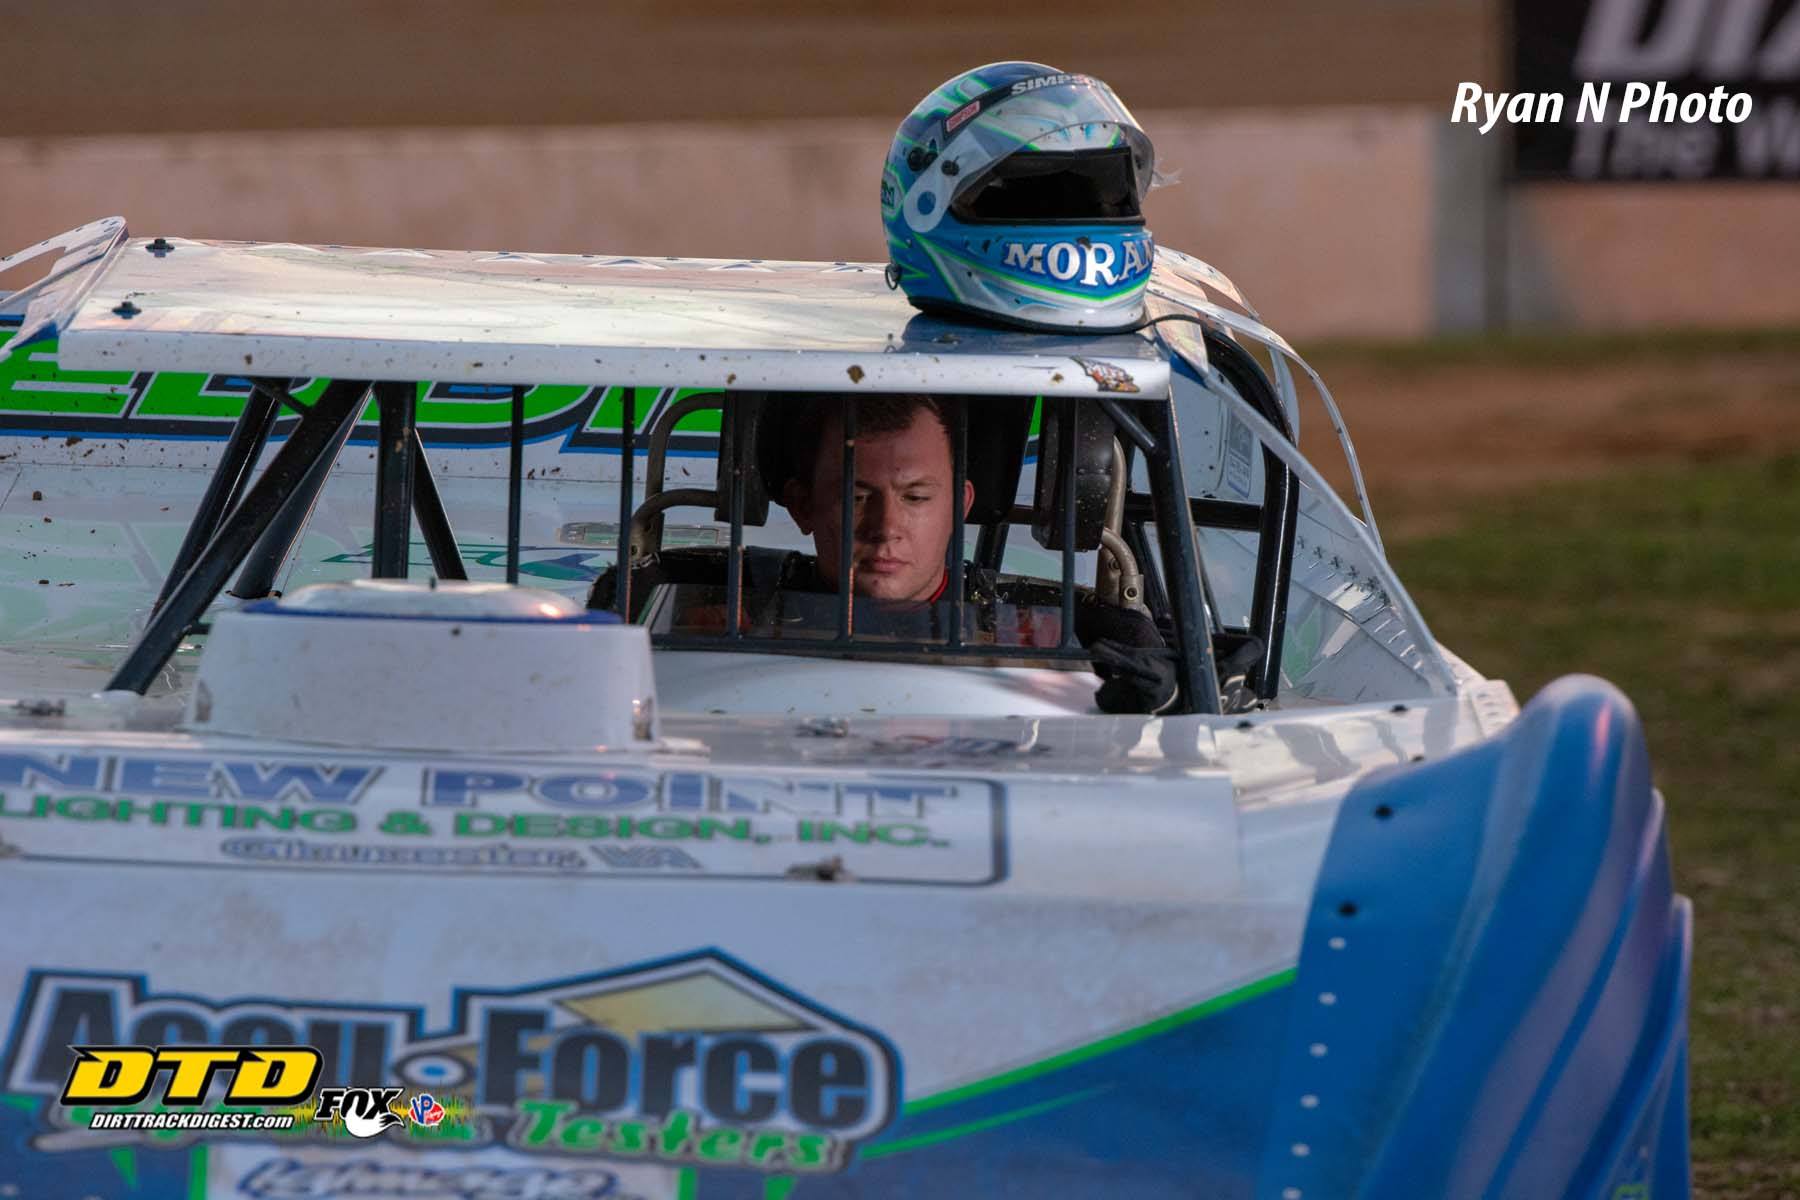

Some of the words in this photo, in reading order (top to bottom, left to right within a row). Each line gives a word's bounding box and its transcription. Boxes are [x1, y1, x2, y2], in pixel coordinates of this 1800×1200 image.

[0, 748, 386, 804] NEW
[421, 766, 958, 818] POINT
[0, 794, 357, 833] LIGHTING
[378, 811, 431, 836] &
[797, 818, 952, 847] INC.
[517, 1100, 832, 1168] Testers
